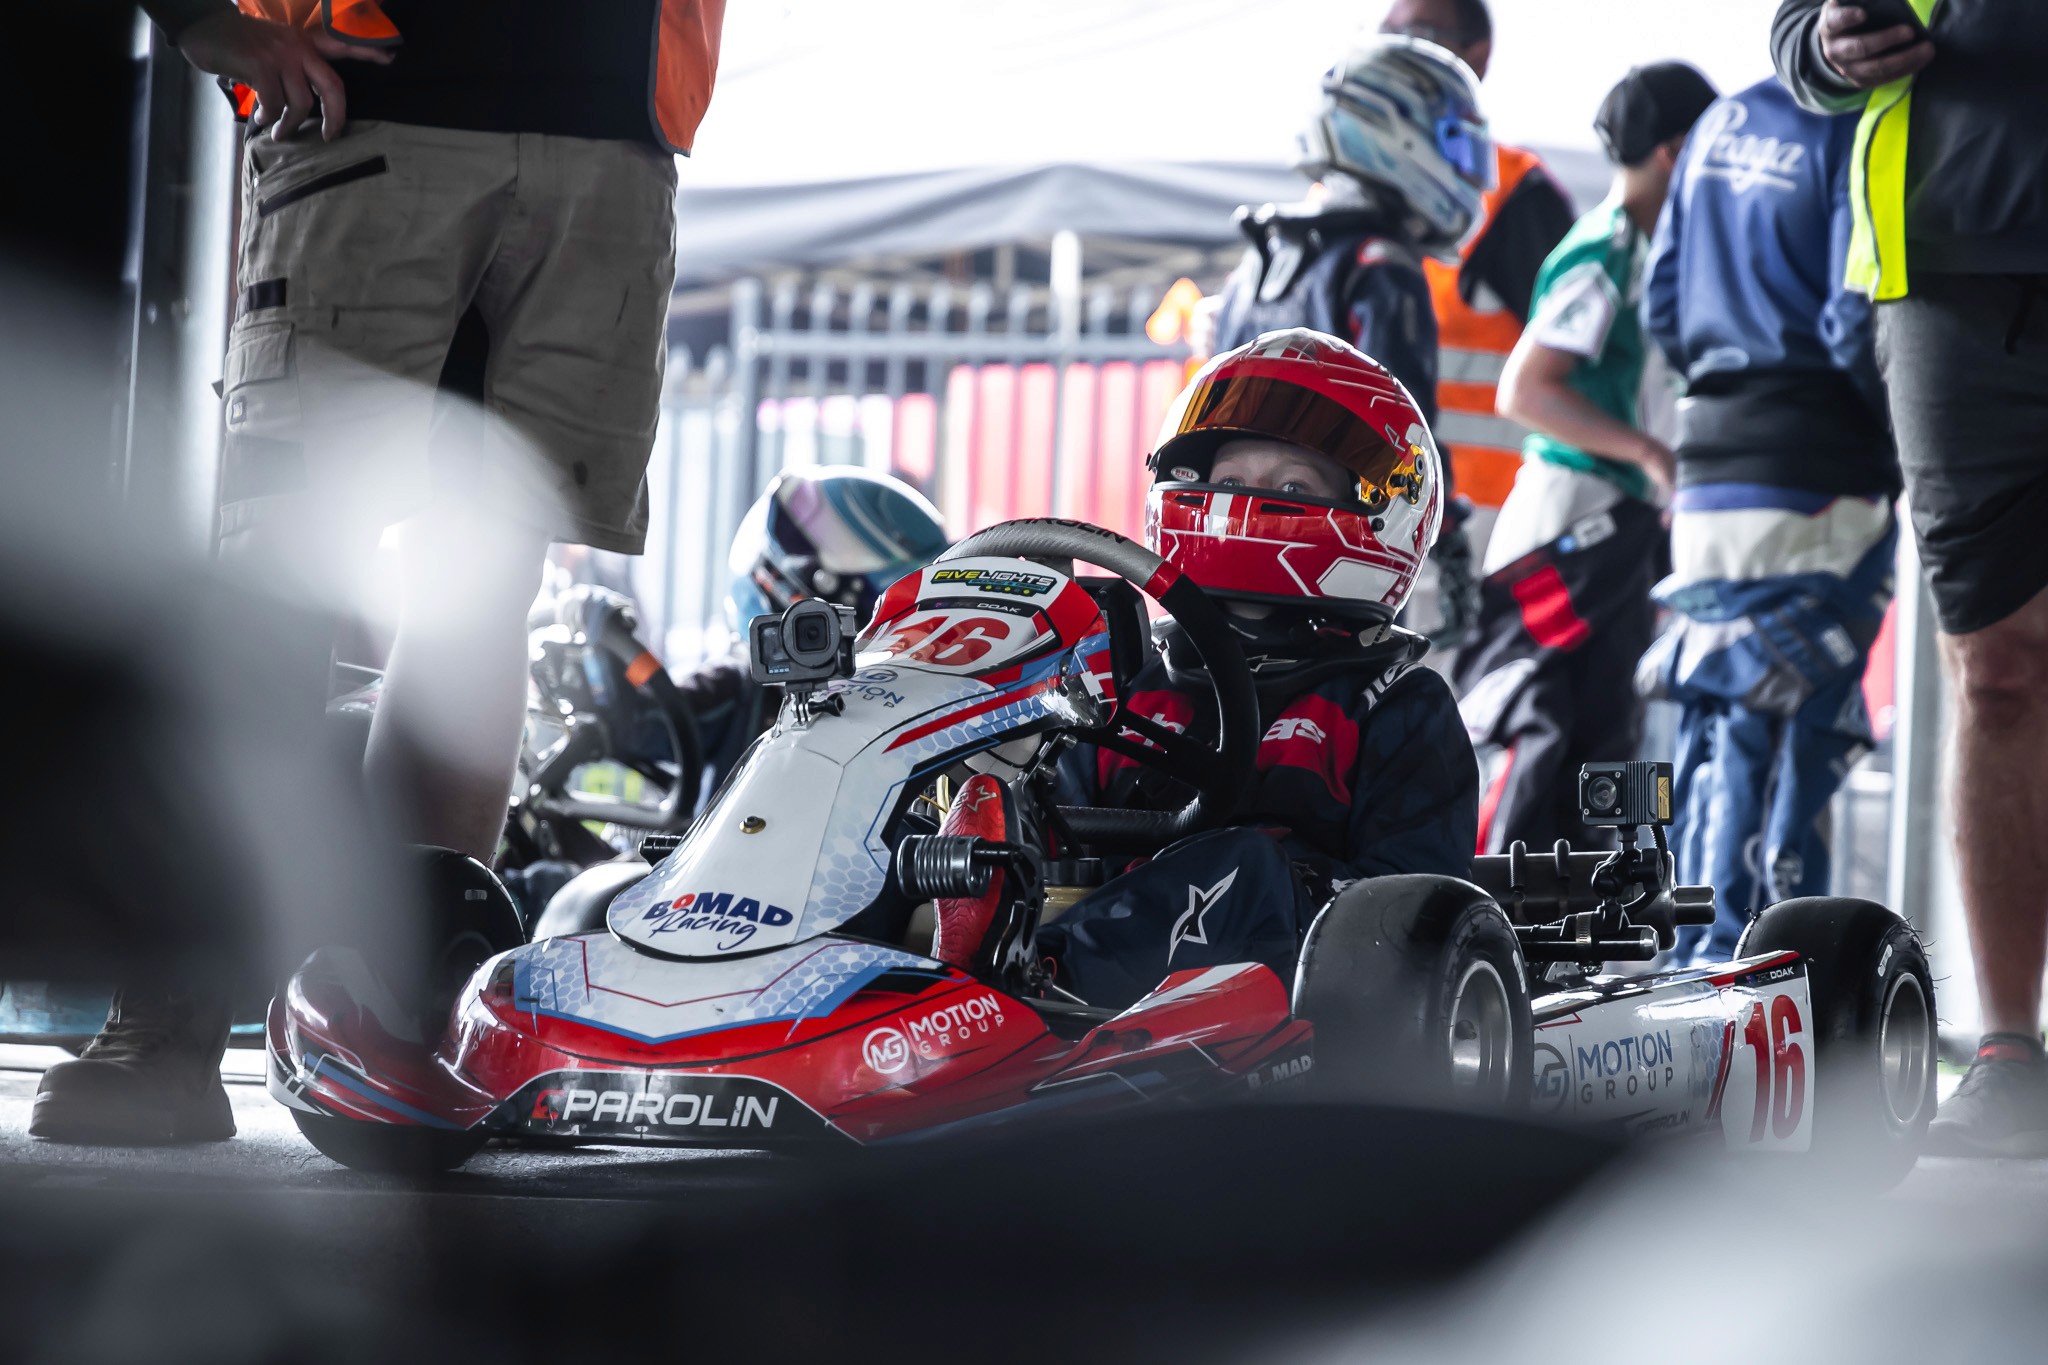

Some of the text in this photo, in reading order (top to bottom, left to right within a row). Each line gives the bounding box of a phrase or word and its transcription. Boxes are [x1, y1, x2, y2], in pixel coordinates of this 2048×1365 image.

[1686, 98, 1805, 195] Praga
[934, 571, 1055, 587] FIVELIGHTS
[976, 602, 1022, 614] DOAK
[888, 616, 1011, 667] 16
[641, 891, 794, 927] BOMAD
[648, 907, 758, 951] Racing
[1769, 966, 1795, 980] DOAK
[908, 993, 1001, 1042] MOTION
[918, 1014, 1005, 1054] GROUP
[1577, 1029, 1673, 1081] MOTION
[1744, 994, 1806, 1144] 16
[1580, 1066, 1674, 1104] GROUP
[562, 1088, 779, 1128] PAROLIN
